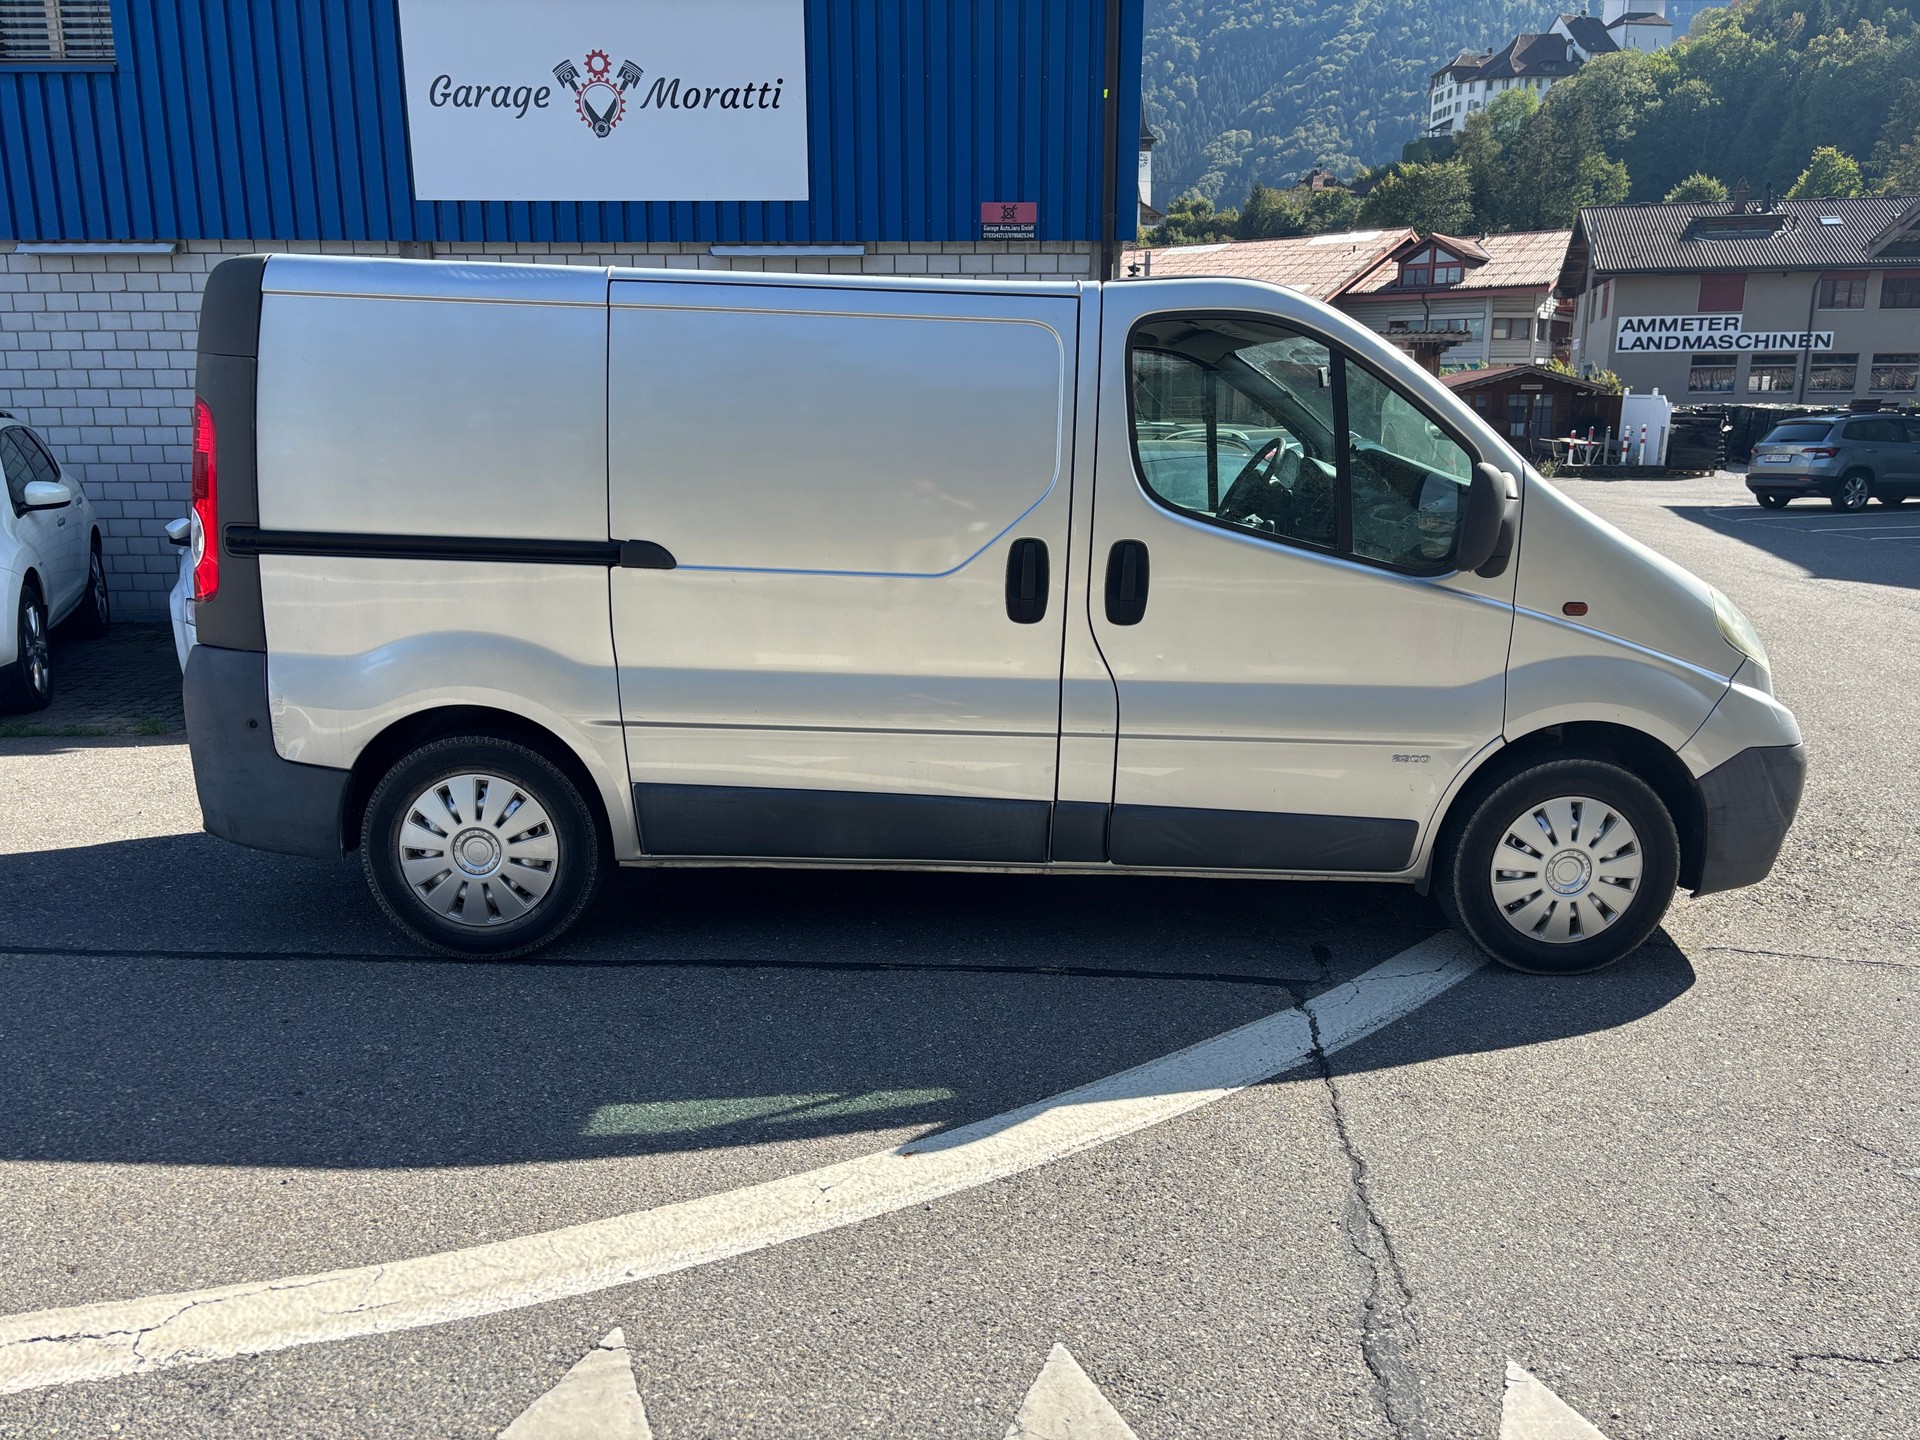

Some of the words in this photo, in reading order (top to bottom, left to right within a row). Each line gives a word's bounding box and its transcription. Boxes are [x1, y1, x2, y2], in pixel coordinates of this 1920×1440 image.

[429, 74, 550, 119] Garage
[640, 78, 784, 109] Moratti
[983, 224, 999, 232] Garage
[1620, 317, 1740, 333] AMMETER
[1618, 333, 1832, 351] LANDMASCHINEN
